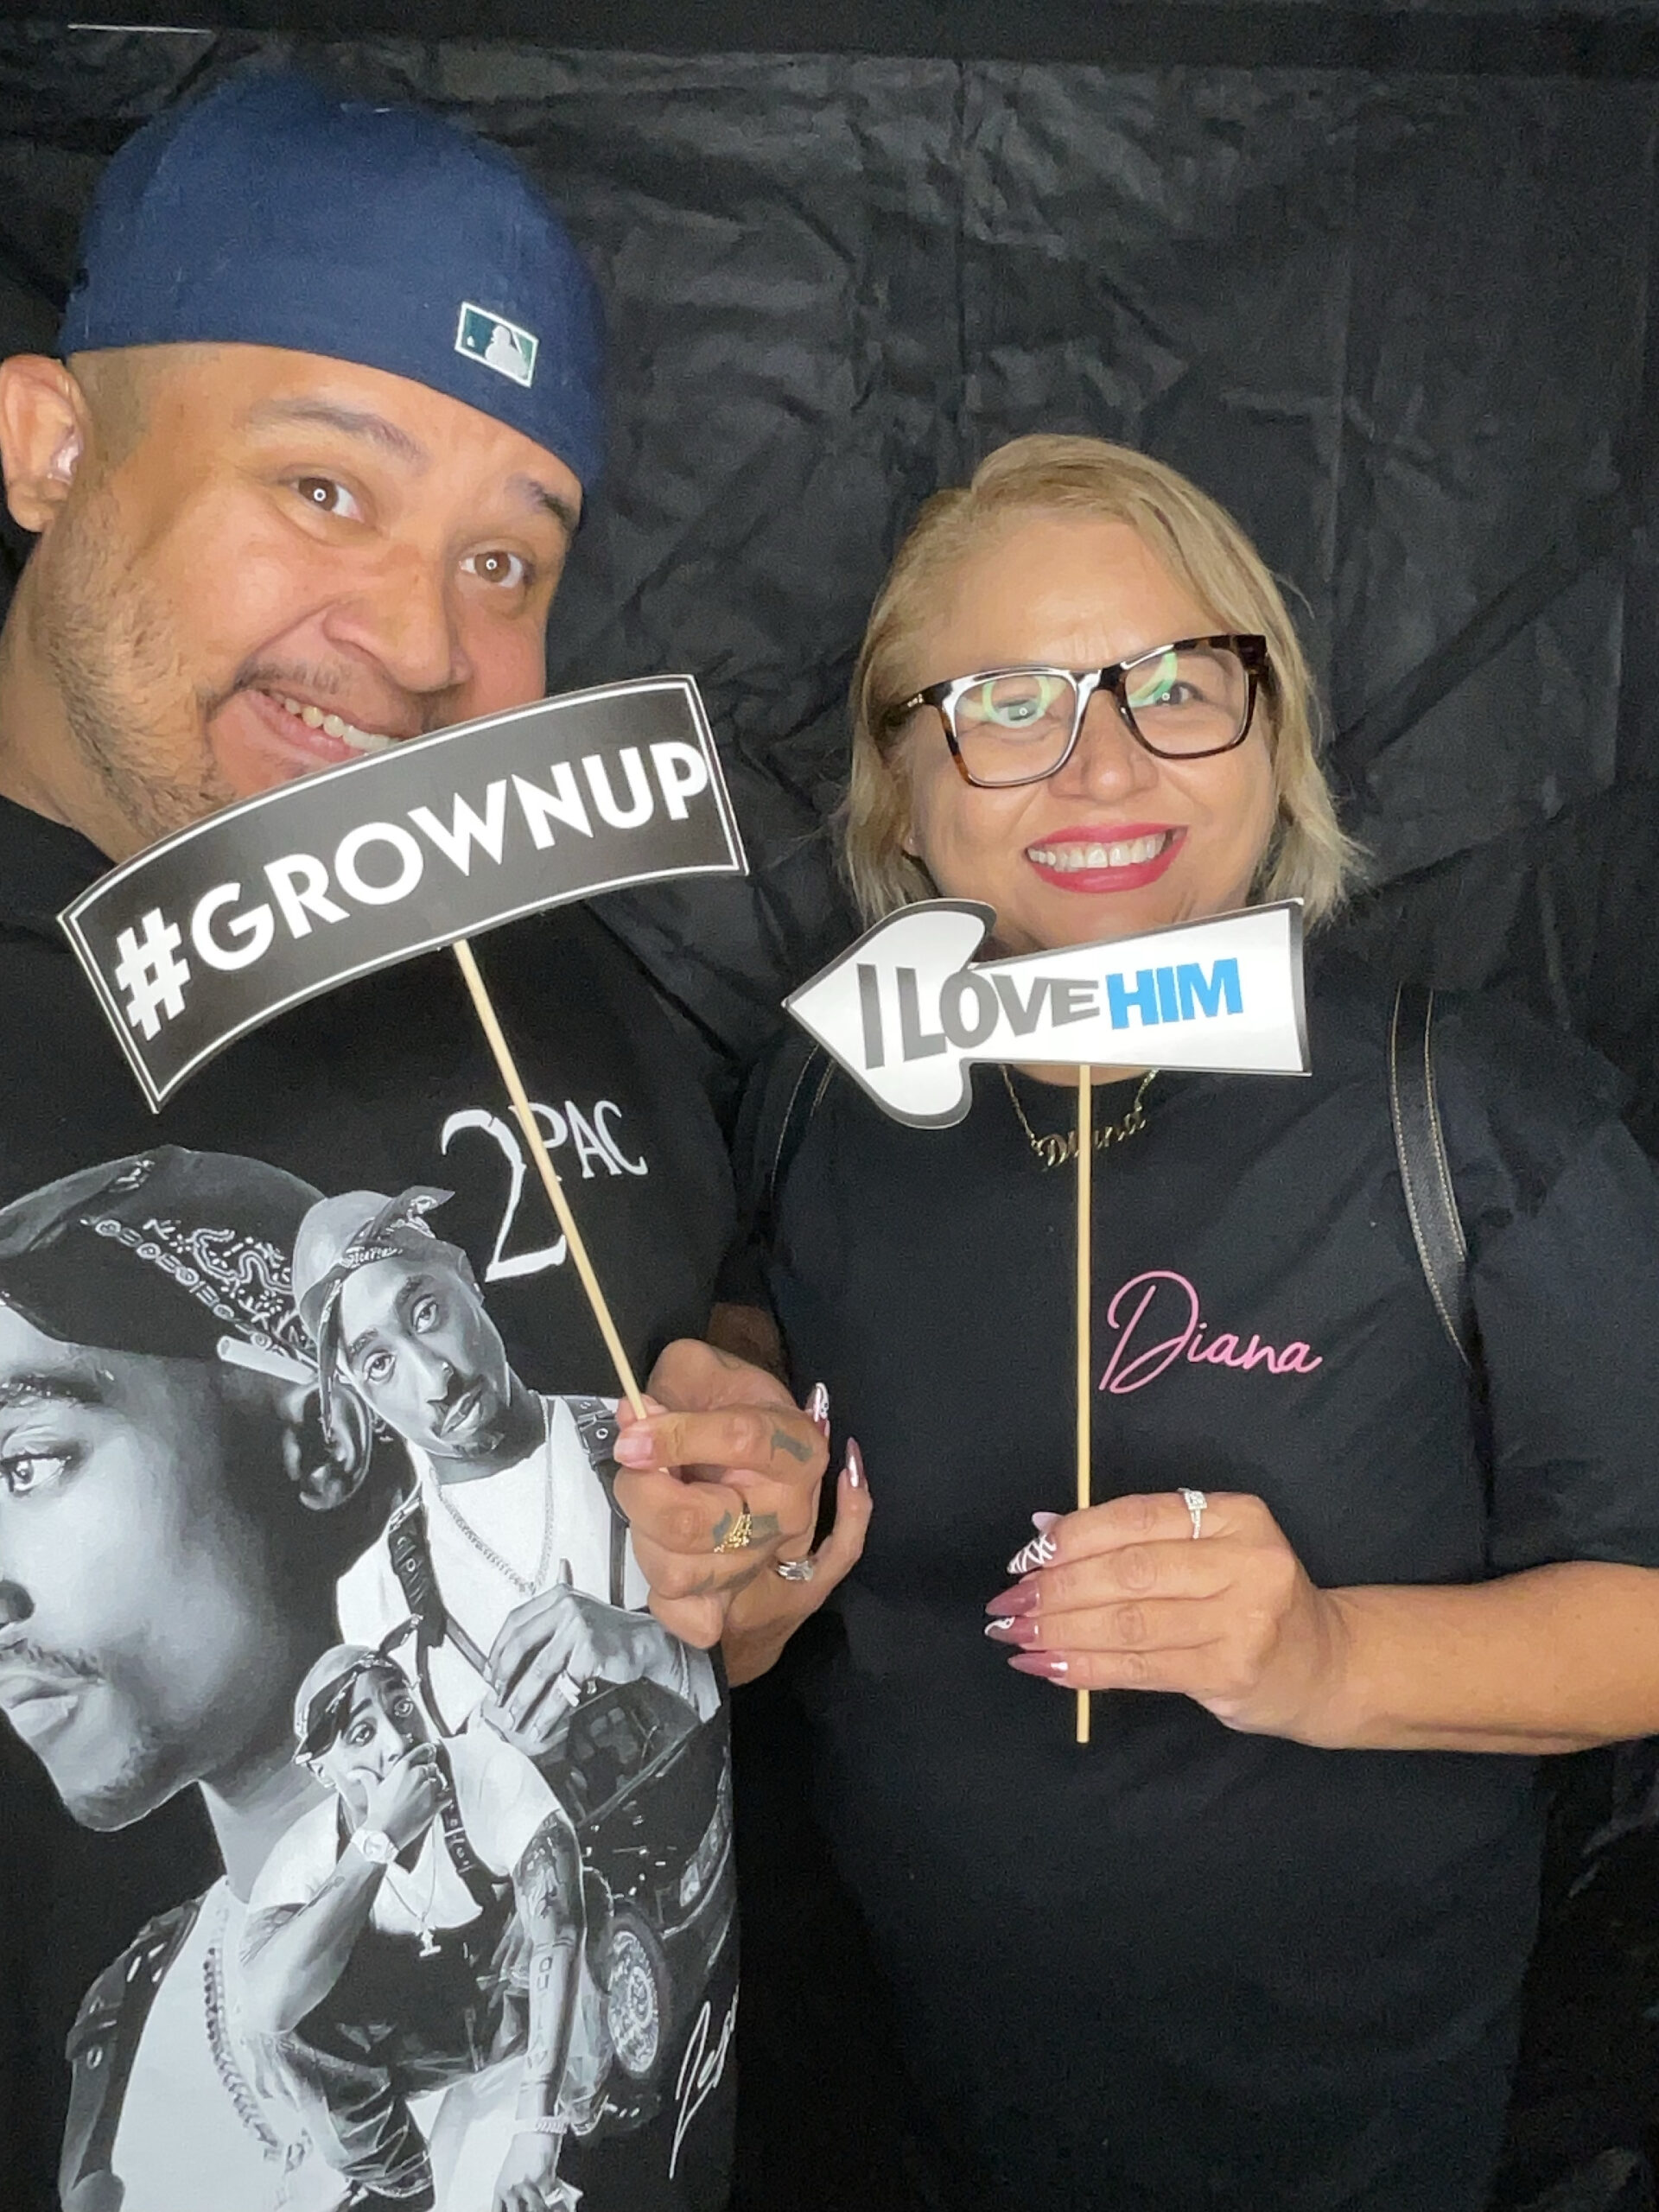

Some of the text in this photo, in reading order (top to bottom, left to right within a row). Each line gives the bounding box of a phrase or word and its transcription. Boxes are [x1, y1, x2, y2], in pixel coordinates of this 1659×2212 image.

[114, 741, 710, 1041] #GROWNUP
[856, 957, 1244, 1071] I LOVE HIM
[1098, 1270, 1323, 1394] Diana
